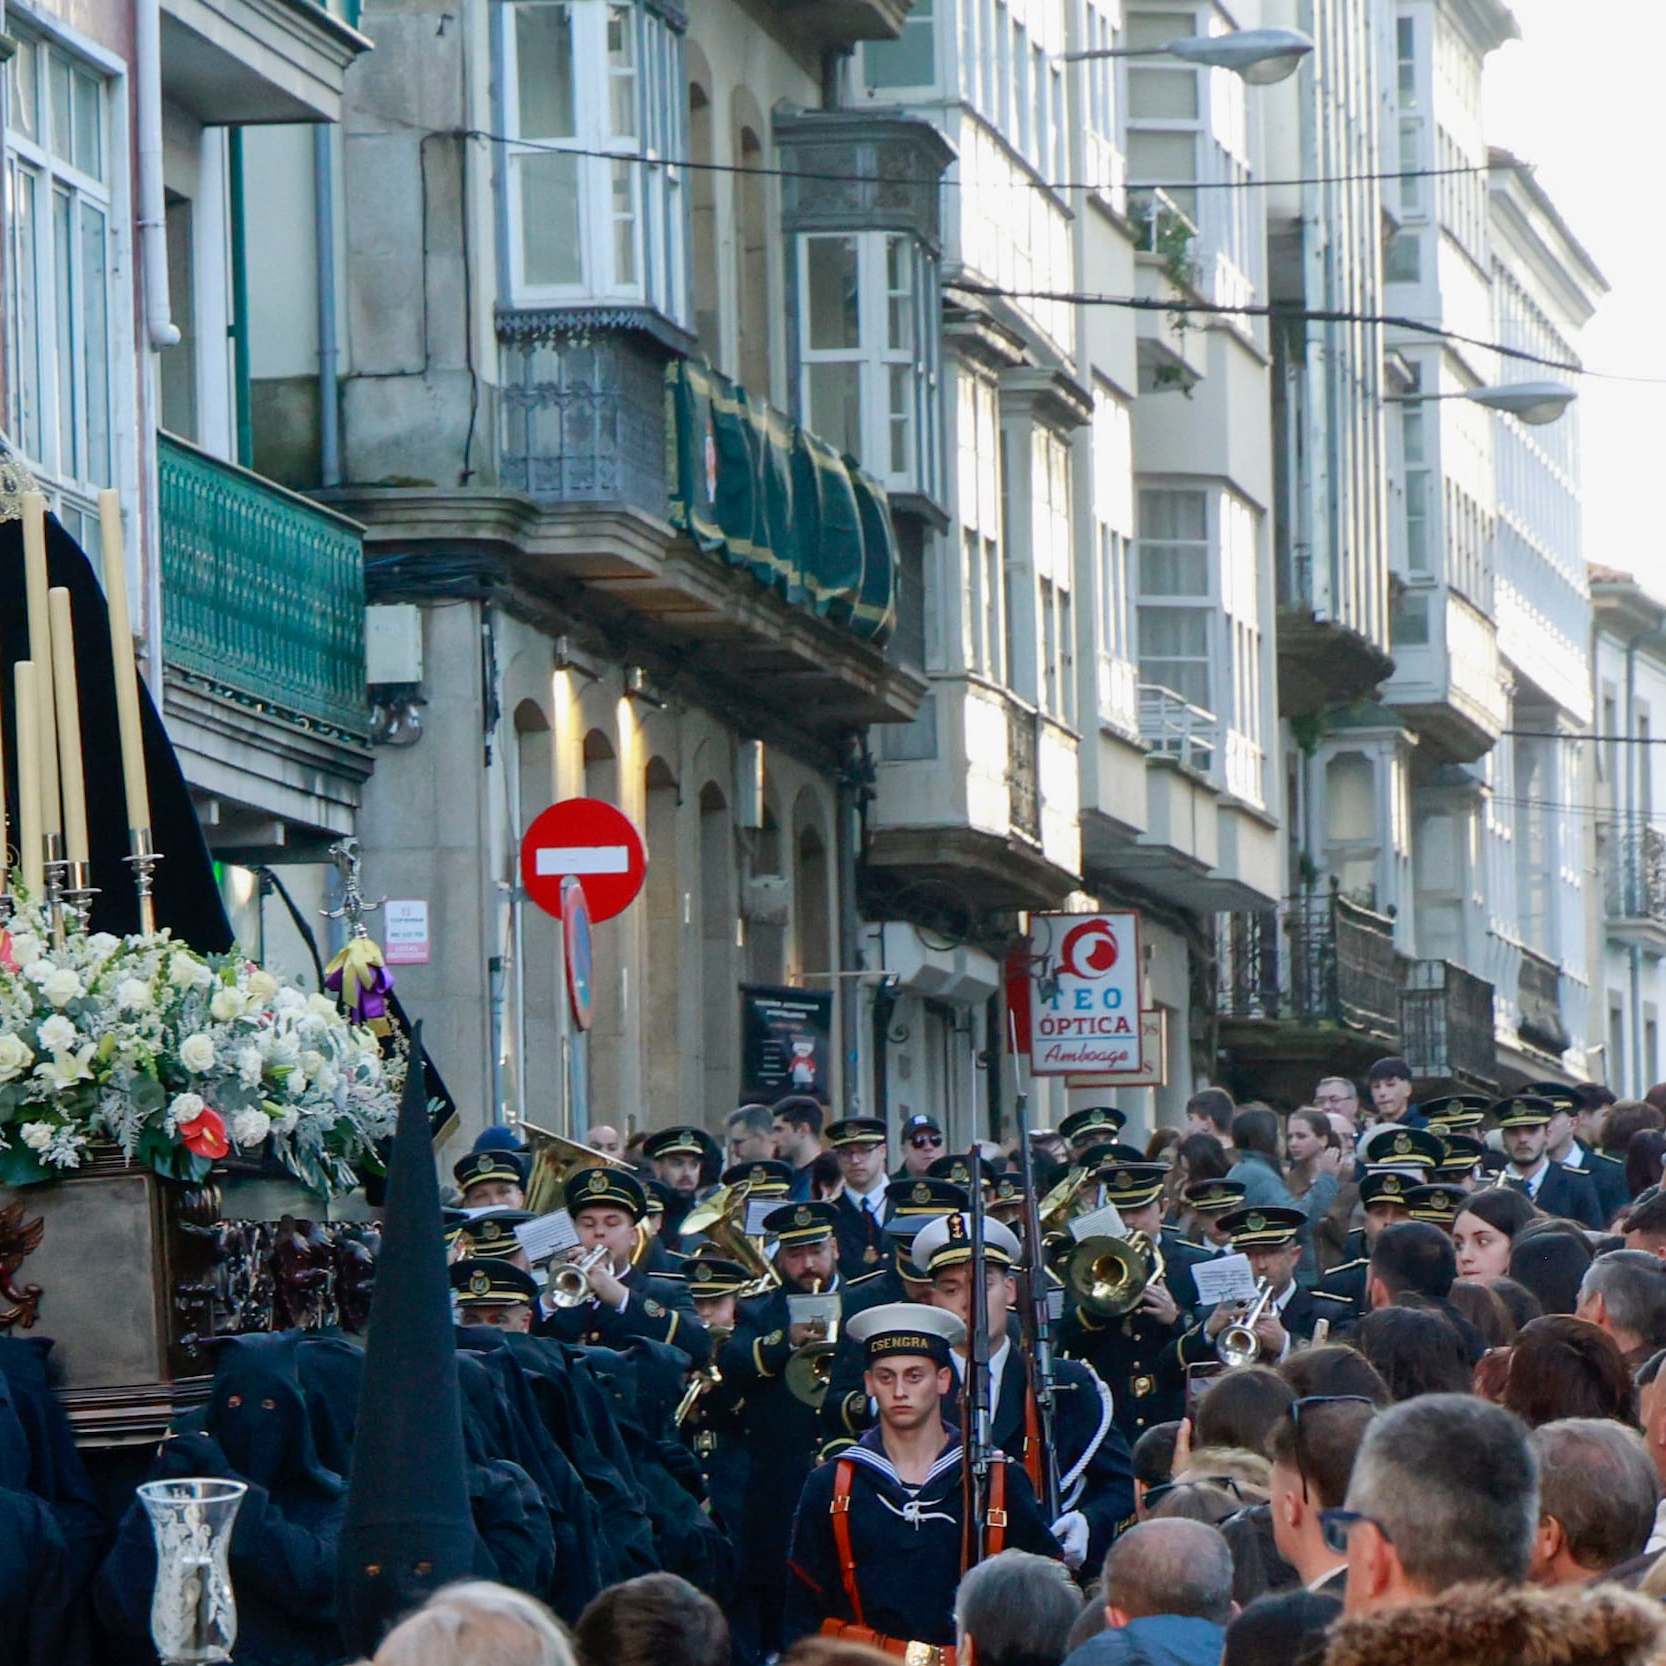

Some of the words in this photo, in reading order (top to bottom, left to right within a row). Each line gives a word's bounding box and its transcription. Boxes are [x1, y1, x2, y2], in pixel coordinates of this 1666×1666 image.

[1049, 987, 1122, 1010] TEO
[1039, 1013, 1133, 1036] ÓPTICA
[1044, 1043, 1130, 1068] Amboage
